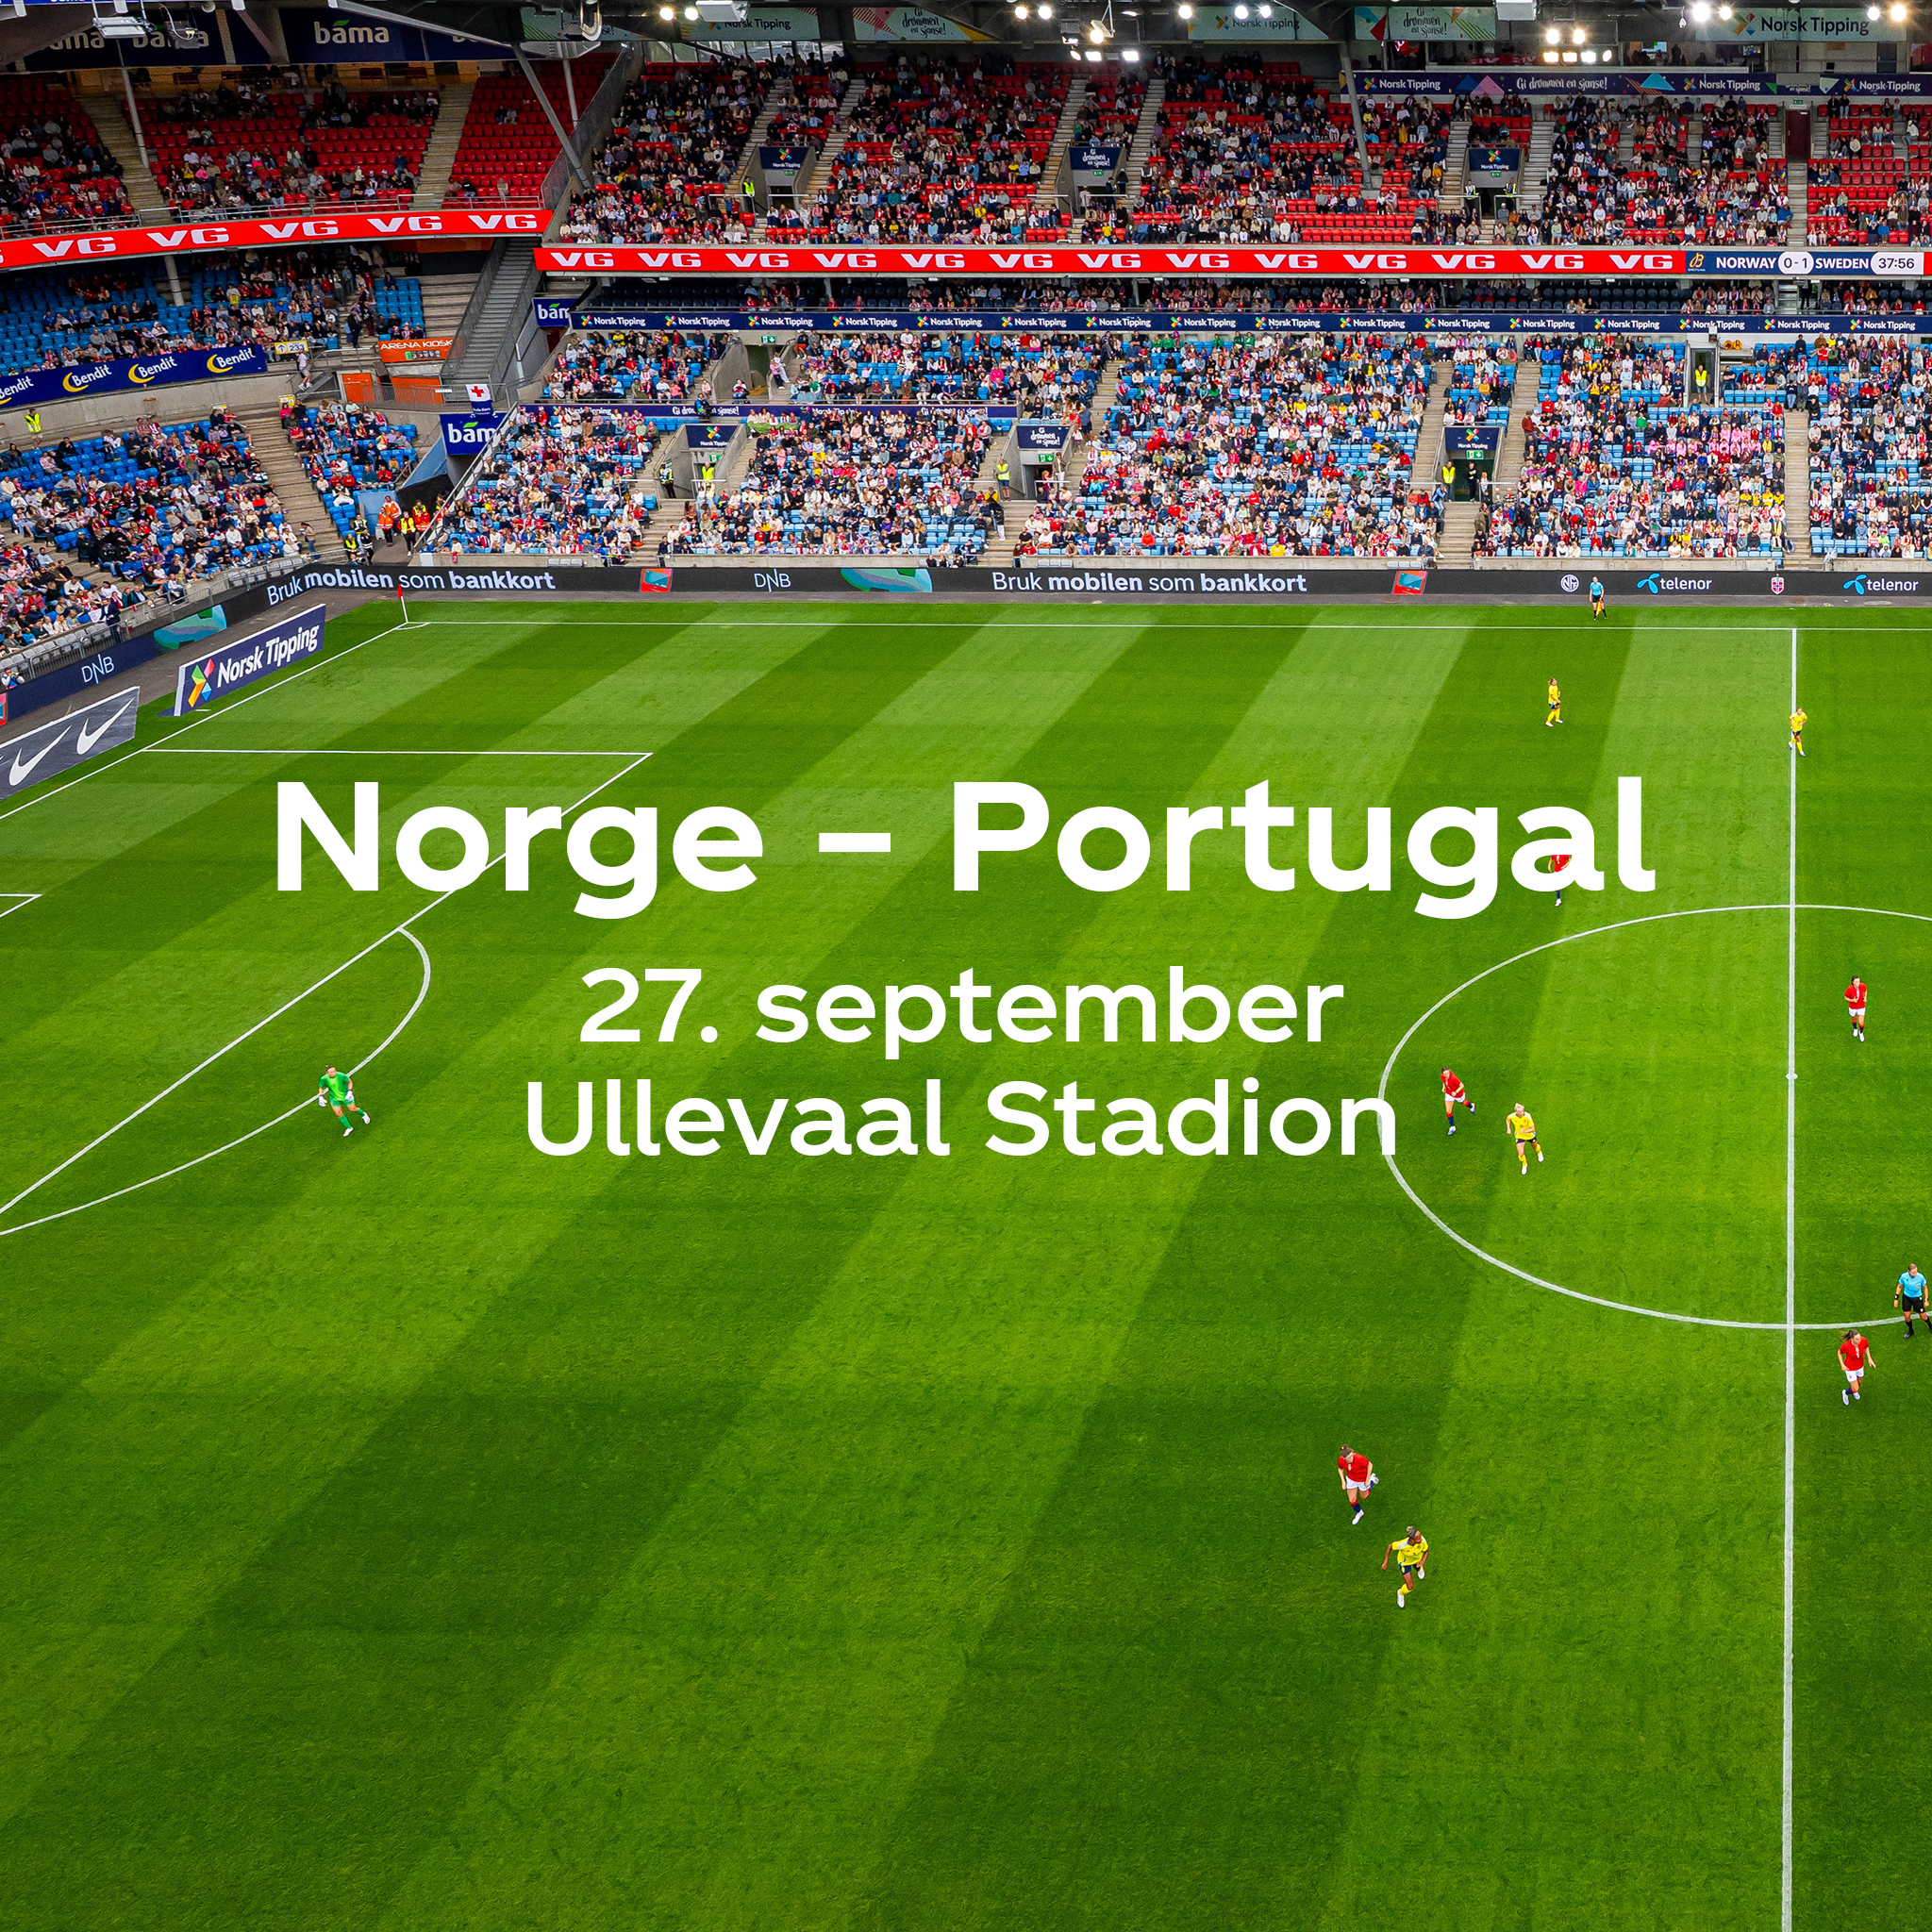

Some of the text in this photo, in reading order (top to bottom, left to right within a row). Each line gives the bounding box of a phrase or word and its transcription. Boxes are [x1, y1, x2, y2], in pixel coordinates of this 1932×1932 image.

[754, 19, 791, 30] Tipping
[1233, 19, 1261, 28] Norsk
[1761, 17, 1869, 36] Norsk Tipping
[133, 31, 209, 48] baa
[315, 22, 389, 44] bama
[50, 31, 105, 50] ma
[1379, 79, 1441, 91] Norsk Tipping
[1516, 77, 1526, 90] Gi
[1578, 77, 1607, 91] sjanse!
[1699, 79, 1760, 92] Norsk Tipping
[1859, 81, 1921, 92] Norsk Tipping
[367, 215, 442, 233] VG
[468, 213, 537, 229] VG
[146, 227, 230, 247] VG
[259, 221, 339, 239] VG
[33, 237, 117, 258] VG
[550, 253, 613, 267] VG
[638, 253, 701, 267] VG
[725, 254, 789, 267] VG
[813, 254, 876, 267] VG
[901, 254, 964, 268] VG
[990, 254, 1053, 268] VG
[1077, 254, 1141, 268] VG
[1166, 254, 1229, 268] VG
[1254, 254, 1317, 268] VG
[1343, 254, 1407, 269] VG
[1432, 254, 1495, 269] VG
[1521, 255, 1584, 269] VG
[1609, 255, 1673, 269] VG
[1716, 257, 1776, 269] NORWAY
[1816, 257, 1869, 270] SWEDEN
[1878, 258, 1915, 270] 37:56
[538, 304, 570, 319] bam
[593, 316, 646, 326] Norsk Tipping
[677, 316, 730, 326] Norsk Tipping
[760, 316, 813, 326] Norsk Tipping
[844, 317, 897, 327] Norsk Tipping
[929, 317, 982, 327] Norsk Tipping
[1014, 317, 1067, 327] Norsk Tipping
[1098, 317, 1151, 327] Norsk Tipping
[1183, 318, 1236, 328] Norsk Tipping
[1268, 318, 1321, 328] Norsk Tipping
[1353, 318, 1406, 328] Norsk Tipping
[1437, 319, 1490, 329] Norsk Tipping
[1523, 319, 1575, 329] Norsk Tipping
[1607, 319, 1660, 329] Norsk Tipping
[1692, 320, 1745, 330] Norsk Tipping
[1777, 320, 1830, 330] Norsk Tipping
[1863, 320, 1916, 330] Norsk Tipping
[380, 340, 453, 350] ARENA KIOSK
[216, 347, 256, 369] Bendit
[138, 356, 177, 377] Bendit
[72, 365, 112, 388] Bendit
[448, 423, 496, 444] bam
[267, 568, 556, 606] Bruk mobilen som bankkort
[755, 568, 791, 592] DNB
[992, 572, 1307, 592] Bruk mobilen som bankkort
[1660, 576, 1712, 591] telenor
[1866, 577, 1919, 591] telenor
[217, 624, 319, 688] Norsk Tipping
[81, 654, 115, 684] DNB
